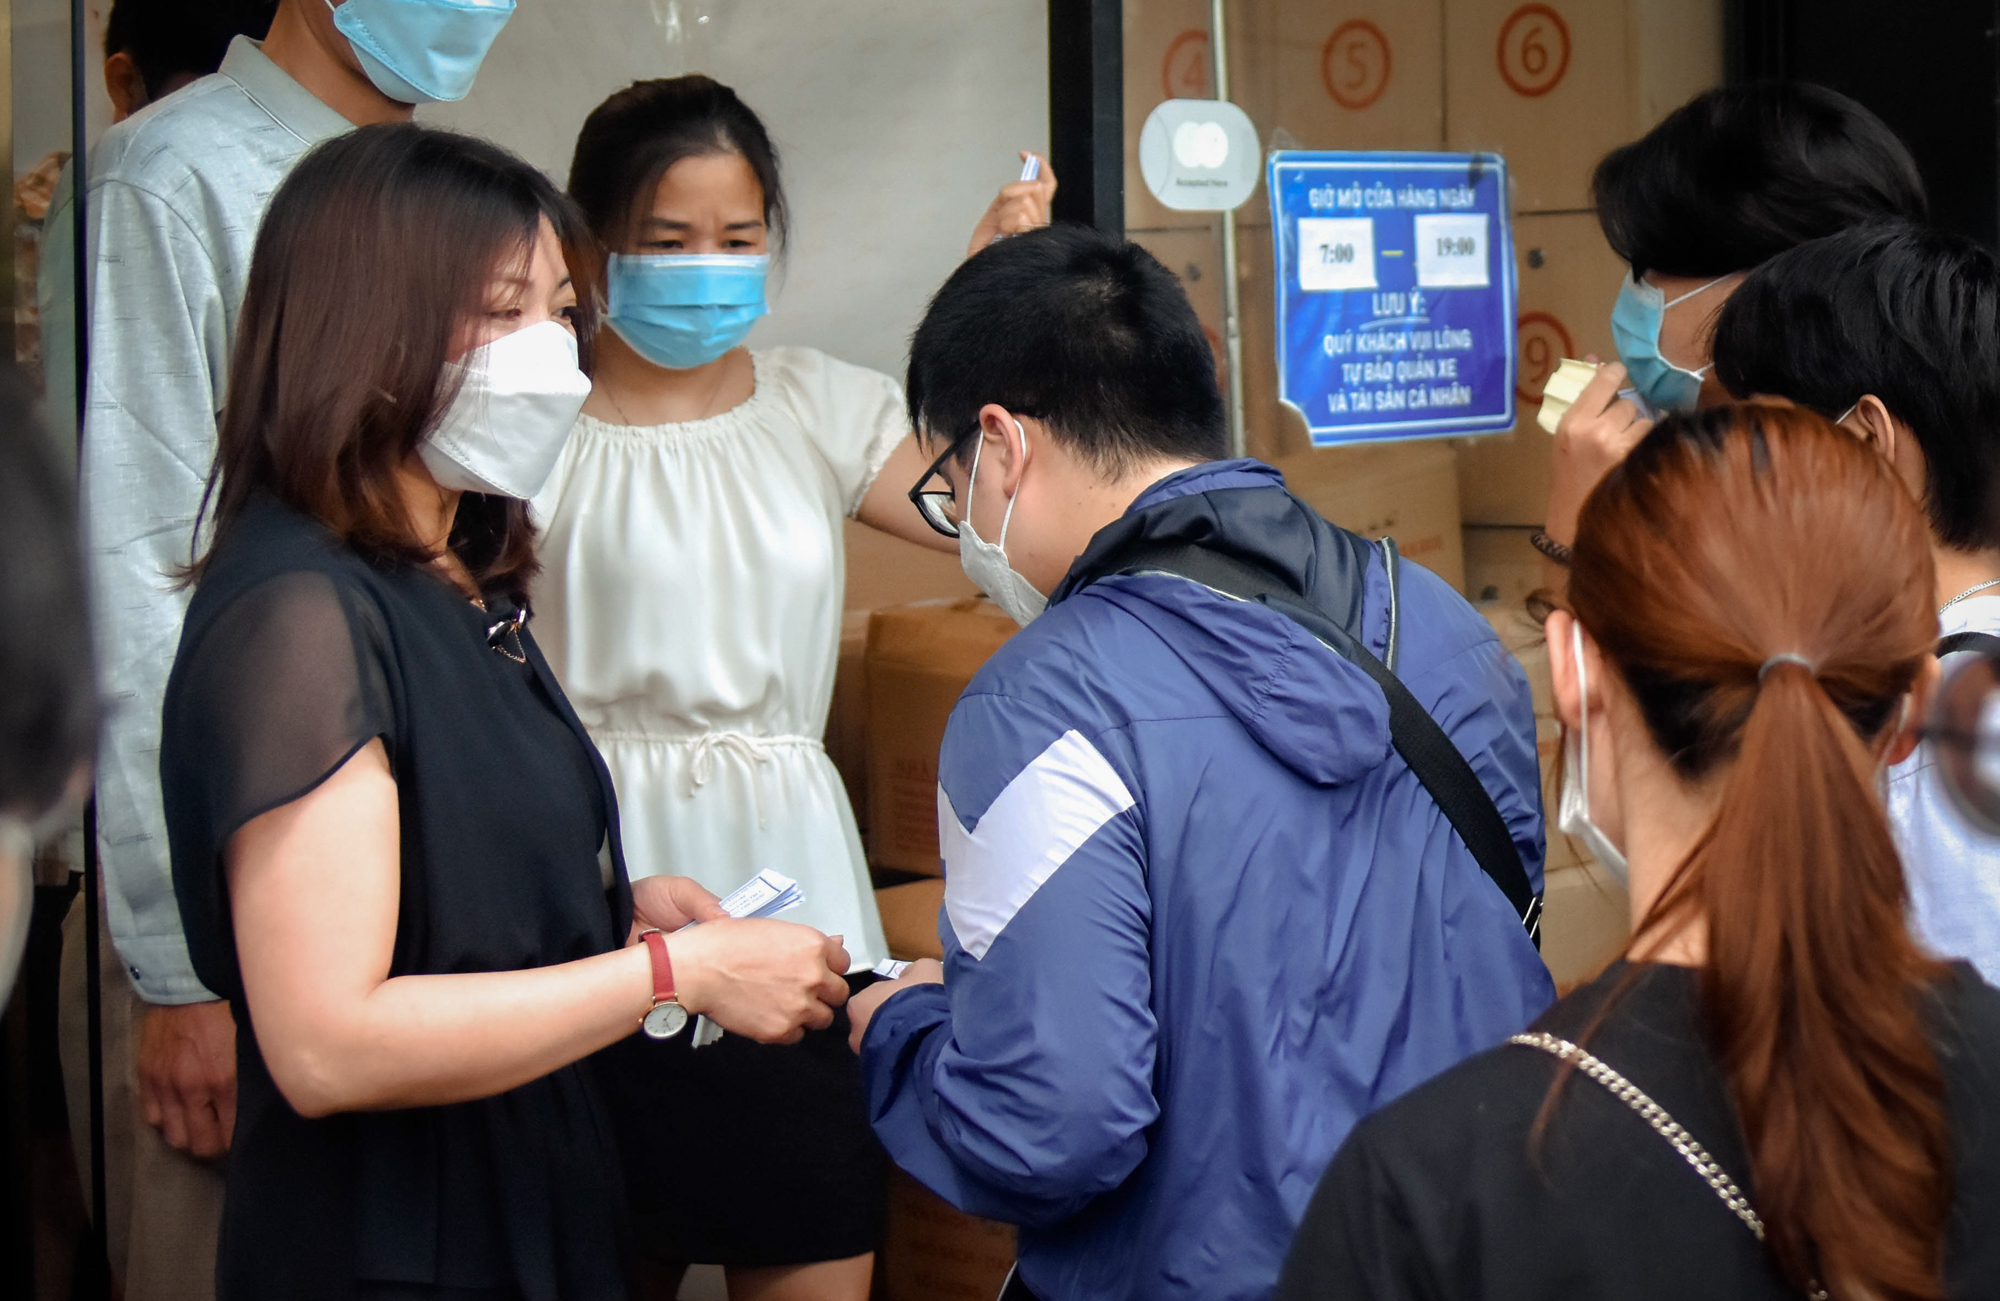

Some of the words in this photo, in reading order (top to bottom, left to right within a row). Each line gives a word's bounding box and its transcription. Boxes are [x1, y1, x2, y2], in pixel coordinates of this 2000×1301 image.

[1345, 42, 1368, 90] 5
[1521, 25, 1548, 76] 6
[1319, 244, 1354, 264] 7:00
[1436, 237, 1475, 256] 19:00
[1437, 358, 1458, 378] XE
[1523, 336, 1551, 384] 9
